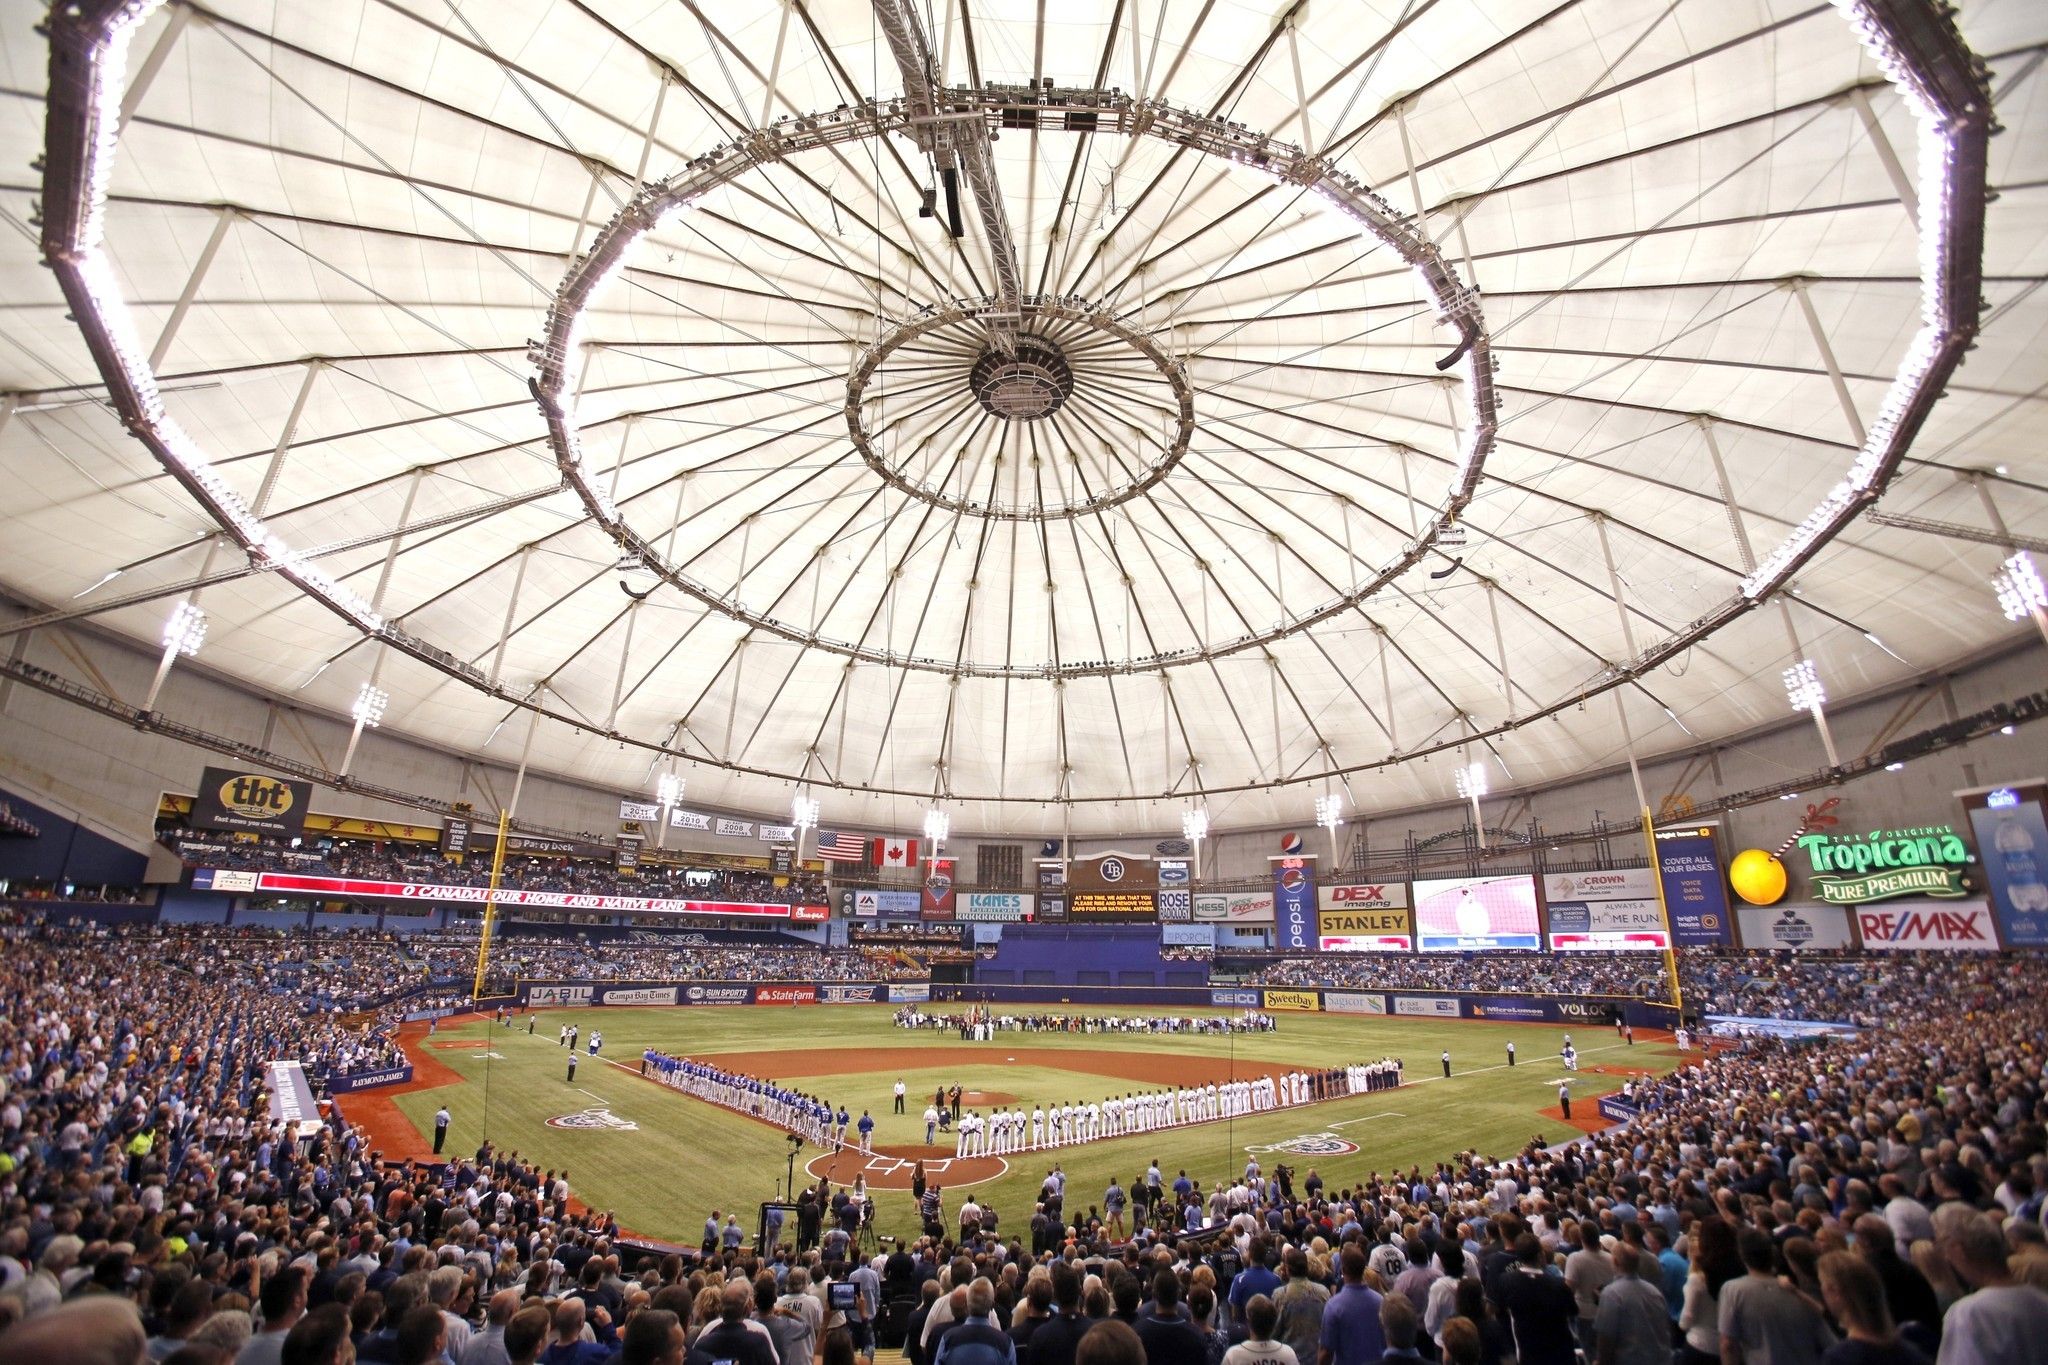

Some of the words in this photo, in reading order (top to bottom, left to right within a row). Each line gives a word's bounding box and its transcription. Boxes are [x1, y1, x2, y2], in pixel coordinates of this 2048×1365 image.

[233, 778, 285, 808] tbt
[674, 820, 705, 829] CHAMPIONS
[680, 816, 700, 824] 2010
[1833, 835, 1861, 843] THE
[1887, 825, 1951, 838] ORIGINAL
[1798, 834, 1967, 873] Tropicana
[1665, 857, 1692, 865] COVER
[1105, 862, 1120, 877] TB
[1662, 865, 1684, 873] YOUR
[1583, 876, 1625, 885] CROWN
[1822, 883, 1865, 900] PURE
[1867, 871, 1948, 895] PREMIUM
[402, 885, 416, 896] O
[418, 887, 487, 901] CANADA!
[491, 891, 521, 903] OUR
[524, 893, 567, 905] HOME
[568, 895, 601, 907] AND
[602, 898, 648, 910] NATIVE
[650, 900, 687, 912] LAND
[1332, 886, 1385, 901] DEX
[970, 894, 1021, 907] KANE'S
[1160, 894, 1189, 907] ROSE
[1344, 900, 1391, 908] imaging
[1160, 907, 1189, 919] RADIOLOGY
[1632, 914, 1660, 923] RUN
[1287, 899, 1306, 948] pepsi
[1323, 916, 1405, 930] STANLEY
[1860, 911, 1986, 942] RE/MAX
[1175, 932, 1210, 943] PORCH
[531, 988, 591, 999] JABIL
[609, 992, 633, 1001] Tampa
[634, 991, 650, 1001] Bay
[650, 990, 671, 999] Times
[706, 989, 720, 997] SUN
[721, 989, 748, 997] SPORTS
[1213, 994, 1257, 1004] GEICO
[1268, 992, 1313, 1007] Sweetbay
[1327, 996, 1363, 1008] Sagicor
[352, 1074, 384, 1088] RAYMOND
[384, 1072, 404, 1082] JAMES
